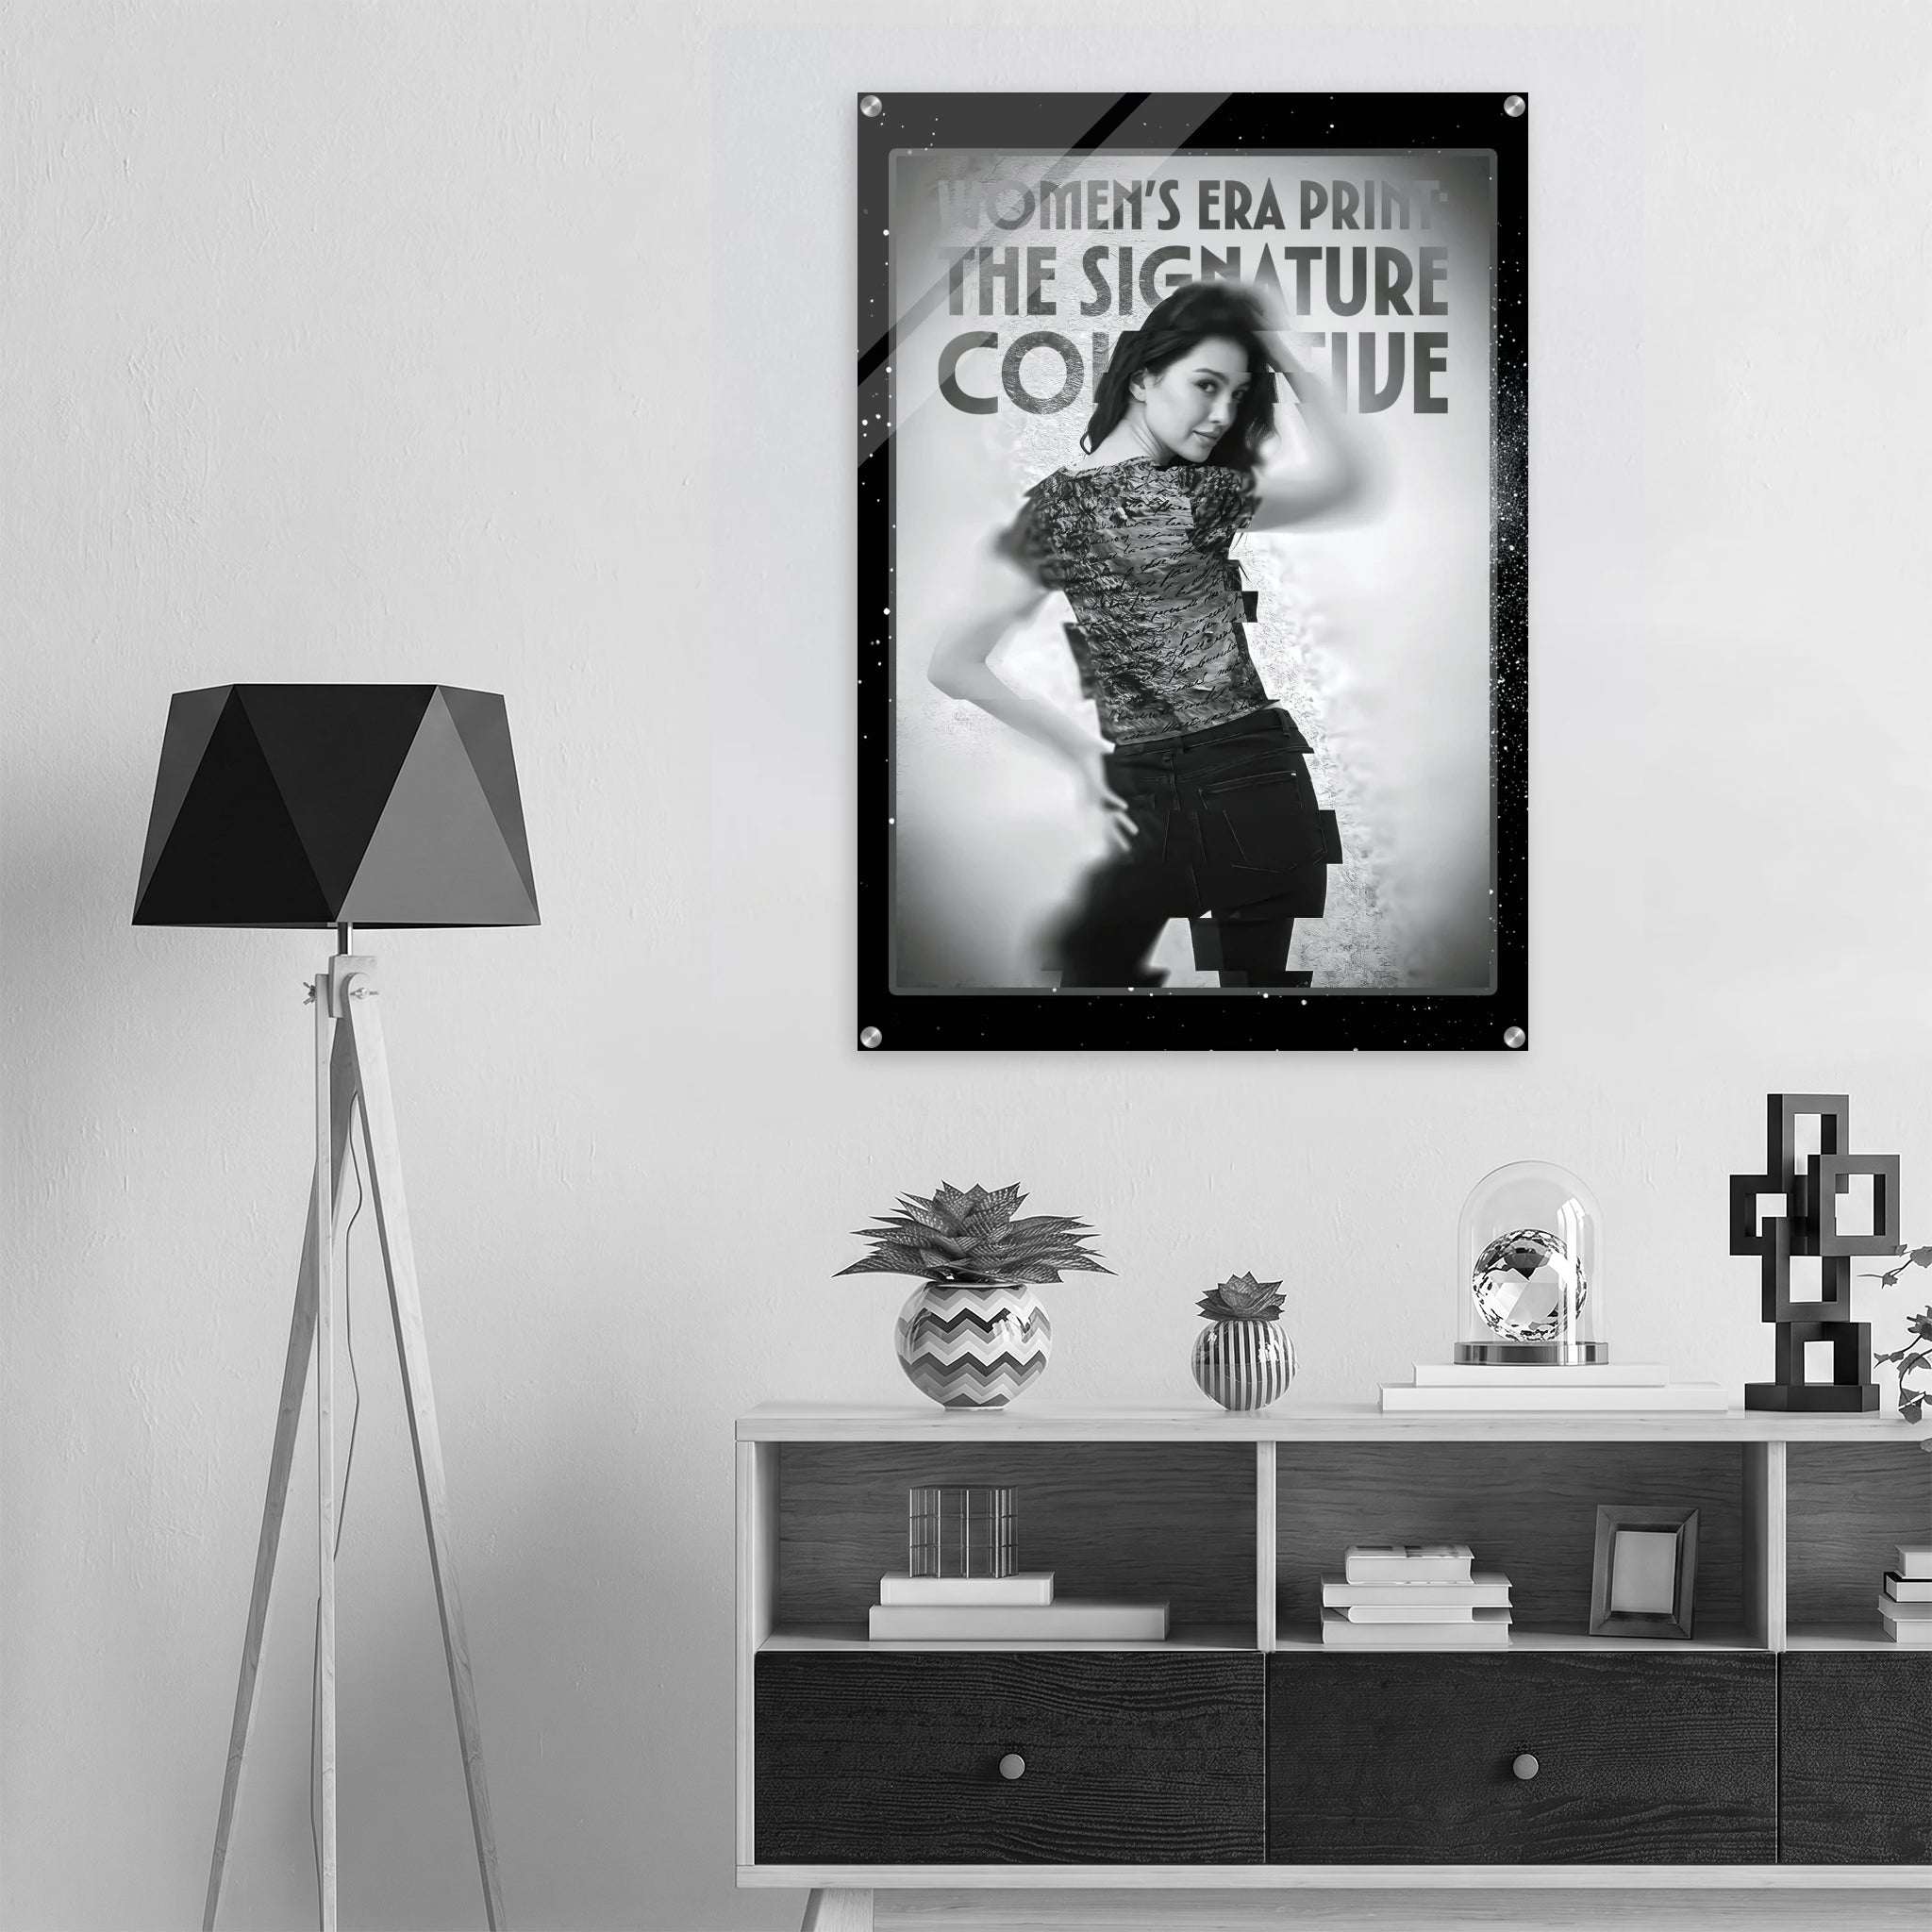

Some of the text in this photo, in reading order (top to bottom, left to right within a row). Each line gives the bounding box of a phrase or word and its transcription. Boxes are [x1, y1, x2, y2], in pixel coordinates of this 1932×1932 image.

[938, 179, 1181, 230] WOMEN'S
[1199, 177, 1286, 230] ERA
[938, 246, 1057, 316] THE
